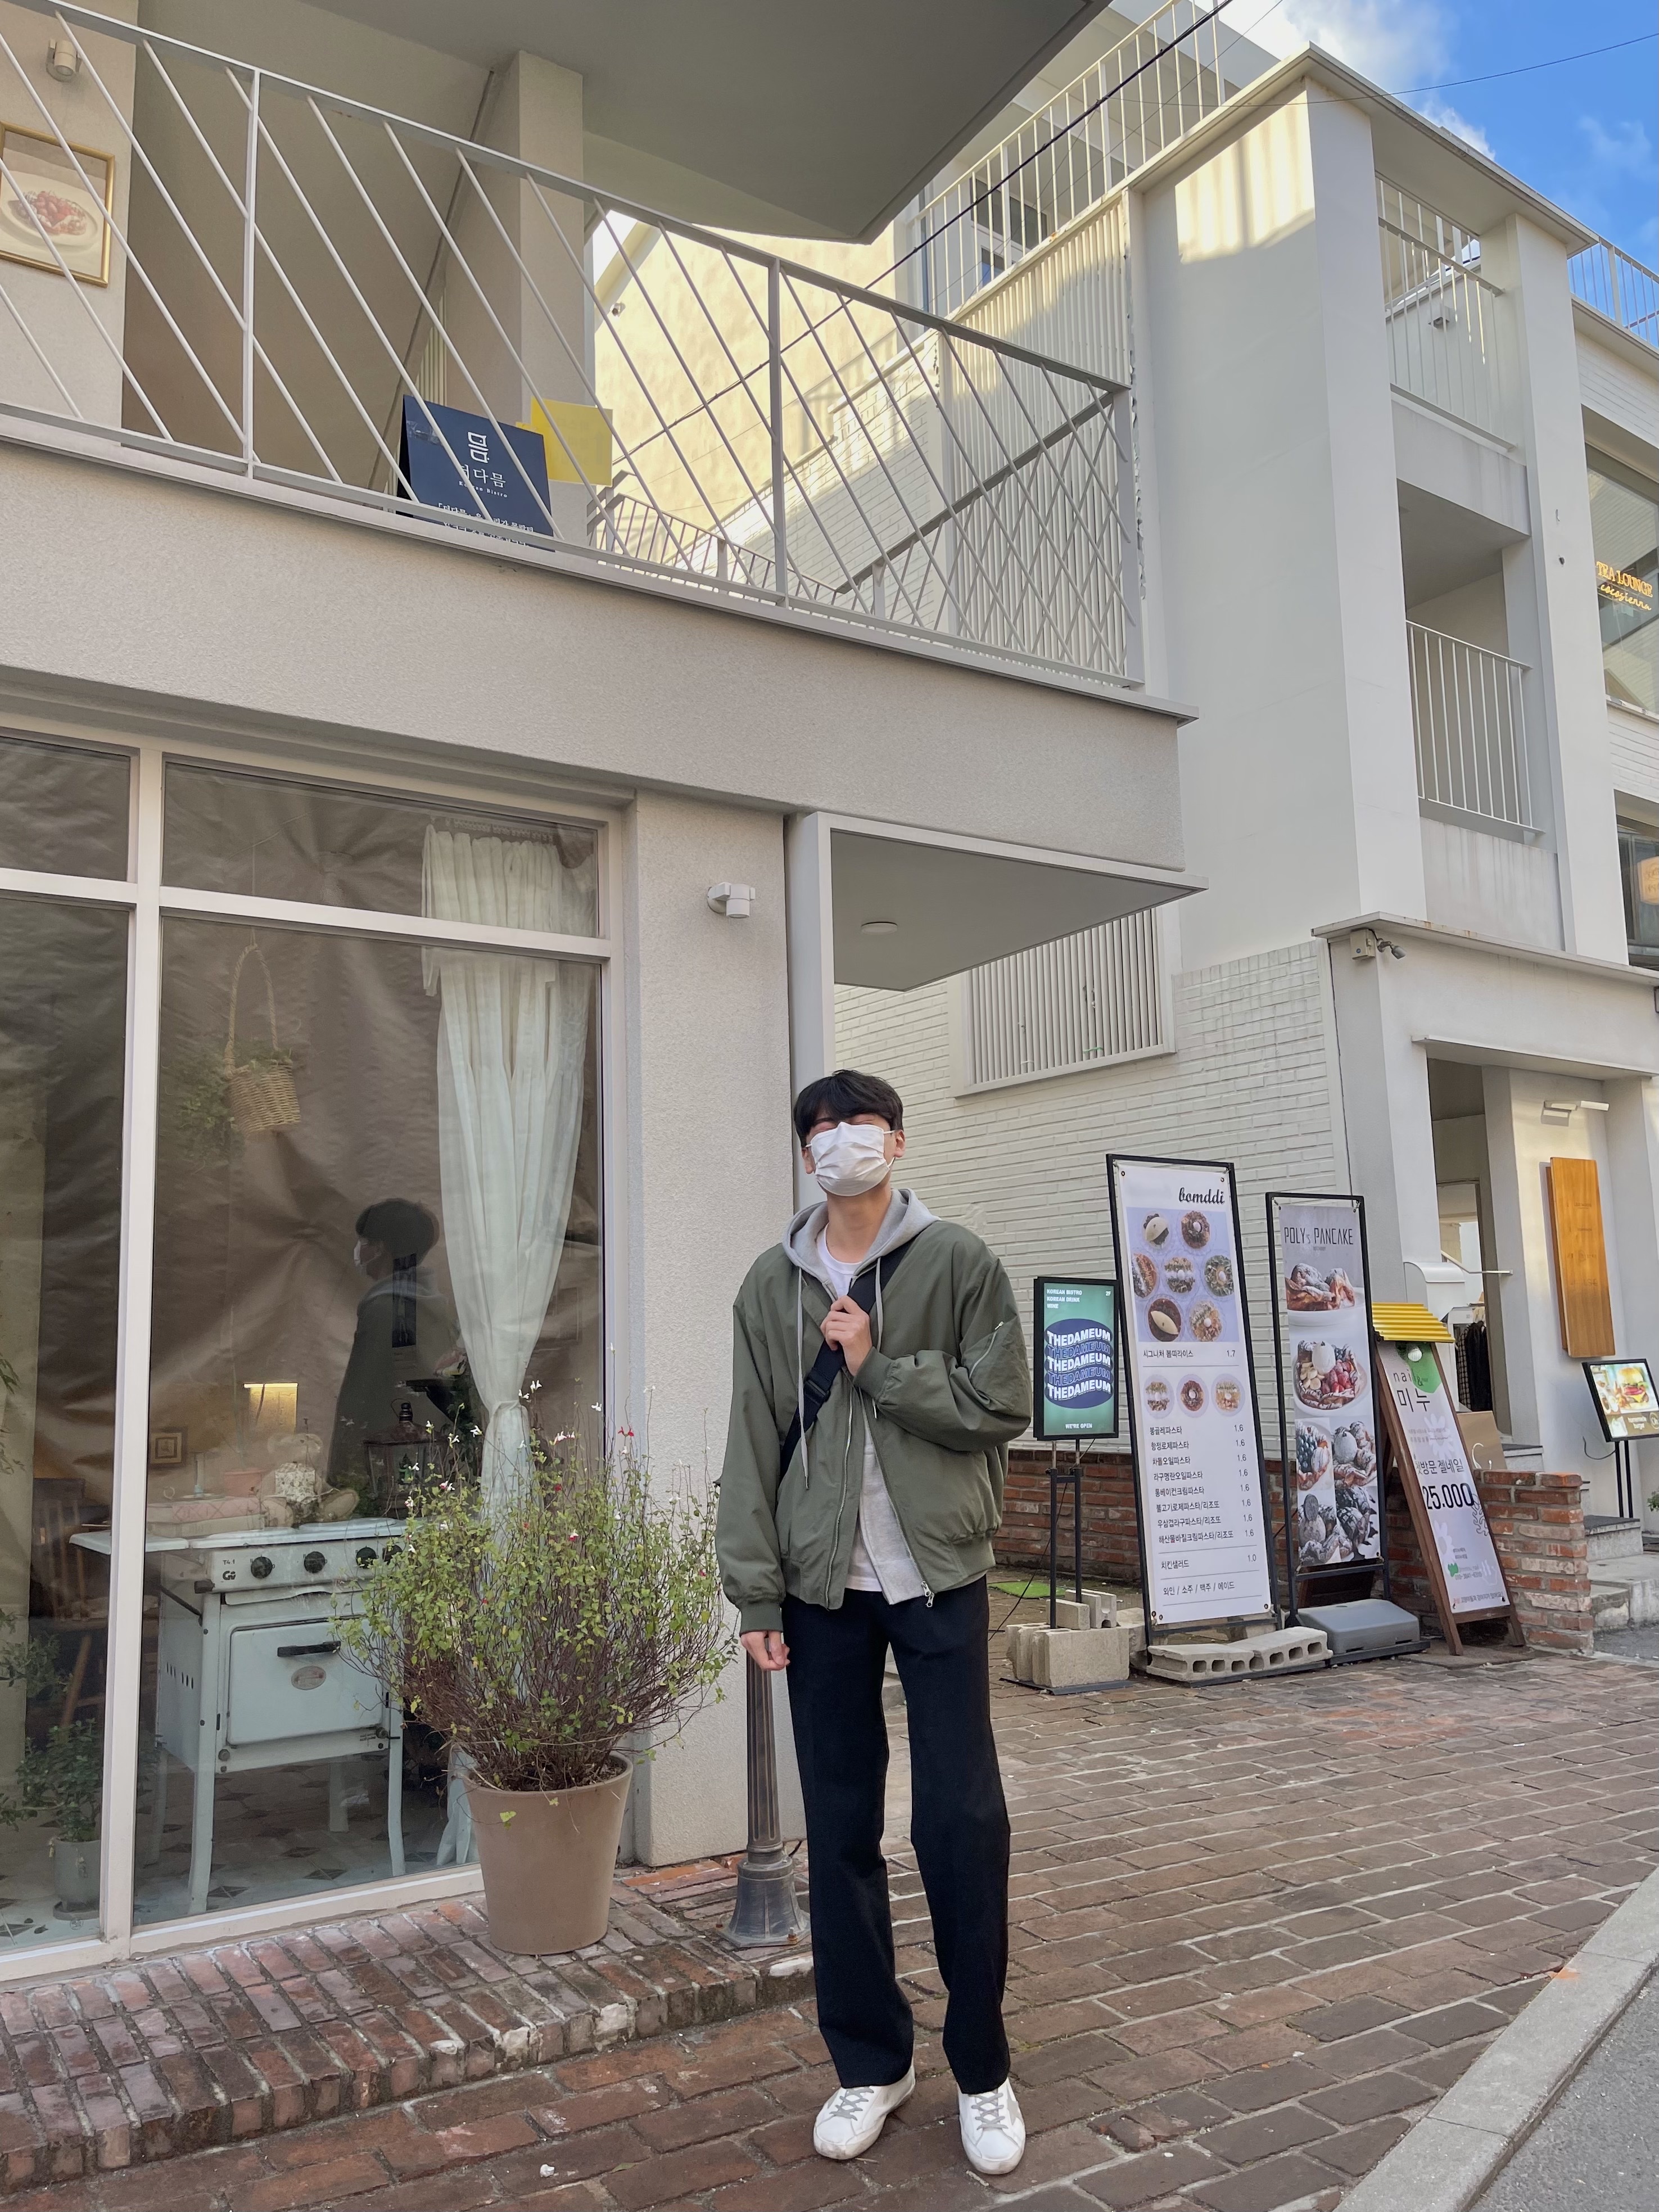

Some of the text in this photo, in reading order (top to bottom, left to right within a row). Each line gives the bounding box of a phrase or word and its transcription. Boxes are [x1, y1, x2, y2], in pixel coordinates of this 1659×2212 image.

[459, 481, 508, 498] Koan Bistro
[1596, 561, 1653, 598] TEA LOUNGE
[1179, 1187, 1226, 1205] bomddi
[1314, 1227, 1354, 1245] PANCAKE
[1047, 1328, 1111, 1347] THEDAMEUM
[1047, 1341, 1111, 1359] THEDAMEUM
[1143, 1350, 1164, 1358] 시그니처
[1166, 1350, 1194, 1358] 봄띠라이스
[1047, 1352, 1111, 1373] THEDAMEUM
[1047, 1367, 1111, 1386] THEDAMEUM
[1047, 1379, 1111, 1400] THEDAMEUM
[1396, 1388, 1430, 1412] 미누
[1150, 1426, 1182, 1435] 봉골레파스타
[1151, 1441, 1189, 1450] 항정로제파스타
[1152, 1456, 1190, 1465] 차돌오일파스타
[1438, 1458, 1465, 1474] 젤네일
[1154, 1471, 1203, 1481] 라구명란오일파스타
[1155, 1486, 1204, 1497] 통베이컨크림파스타
[1422, 1482, 1474, 1510] 25.000
[1156, 1501, 1220, 1512] 불고기로제파스타/리조또
[1158, 1516, 1222, 1528] 우삼겹라구파스타/리조또
[1159, 1531, 1233, 1544] 해산물바질크림파스타/리조또
[1161, 1554, 1256, 1569] 치킨샐러드 1.0
[1163, 1586, 1175, 1596] 와인
[1182, 1585, 1194, 1594] 소주
[1200, 1583, 1212, 1592] 맥주
[1218, 1581, 1235, 1590] 에이드
